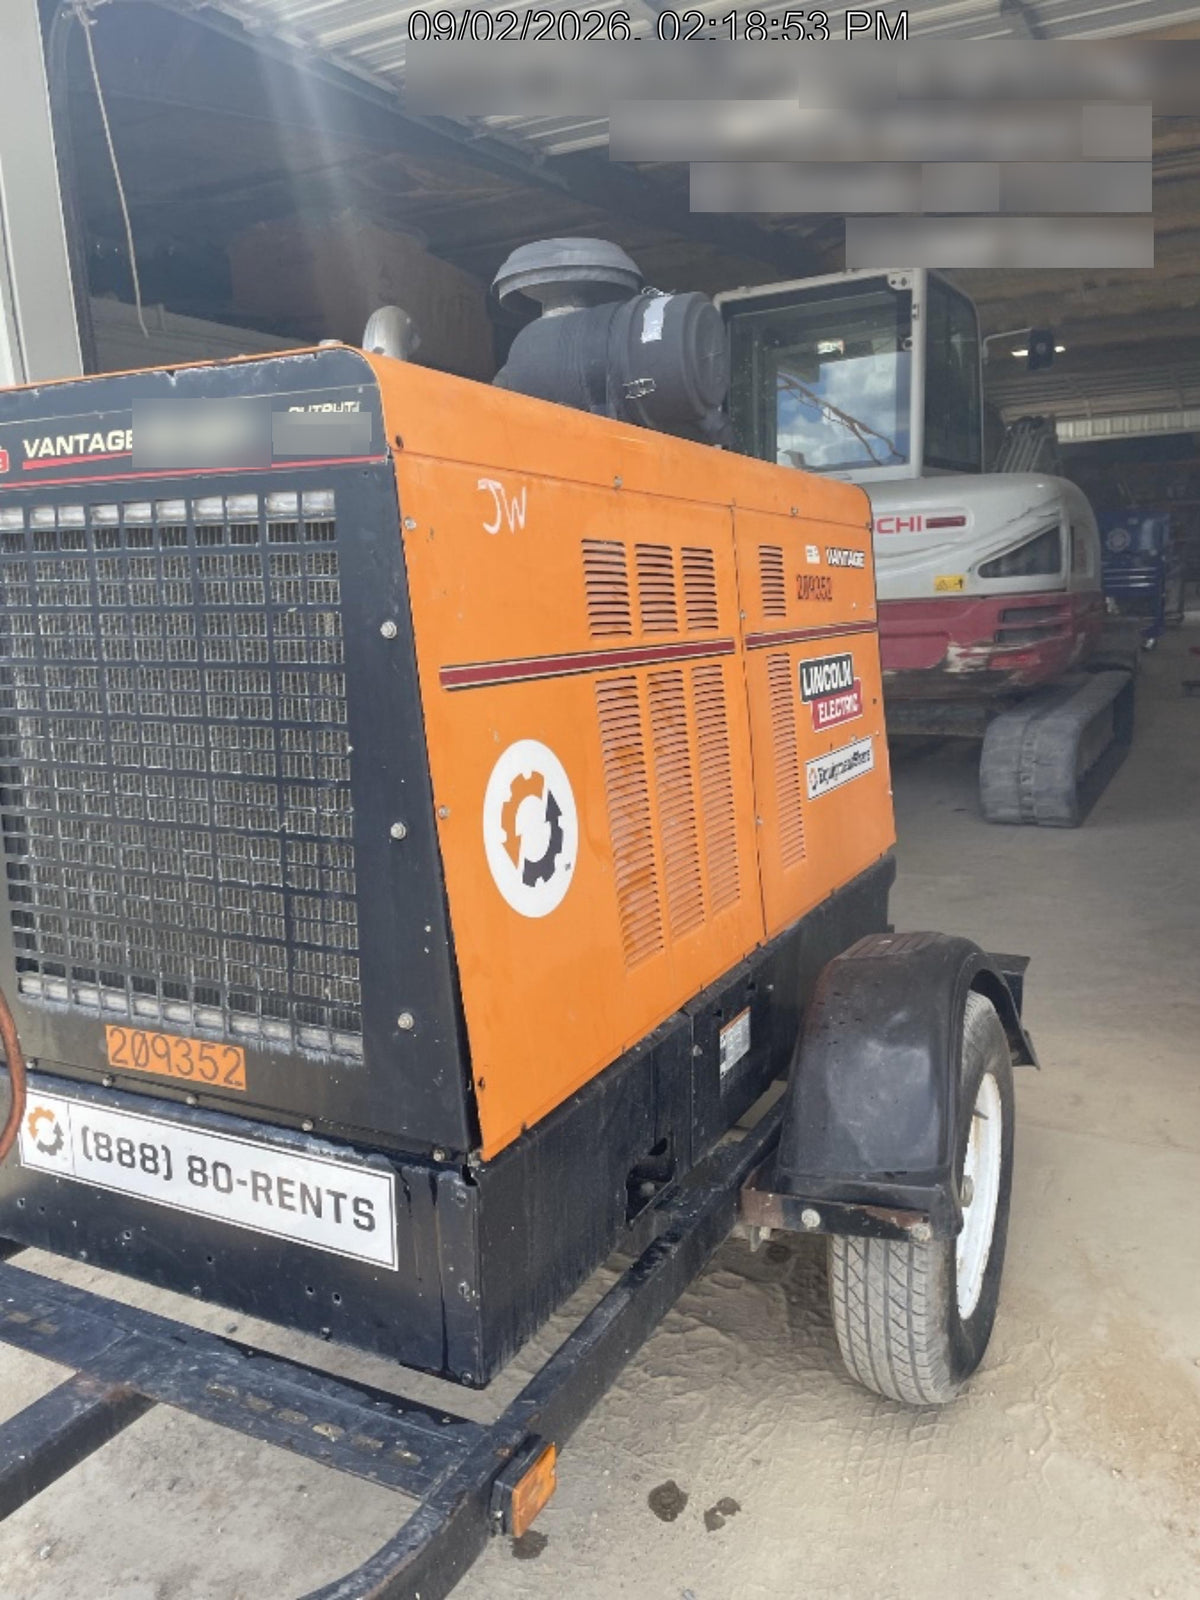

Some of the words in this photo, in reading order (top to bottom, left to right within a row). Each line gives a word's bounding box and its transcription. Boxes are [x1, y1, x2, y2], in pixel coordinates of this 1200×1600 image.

[22, 429, 133, 458] VANTAGE
[477, 478, 527, 535] JW
[873, 515, 922, 534] CHI
[825, 547, 865, 569] VANTAGE
[802, 660, 853, 696] LINCOLN
[817, 693, 858, 723] ELECTRIC
[109, 1027, 244, 1087] 209352
[81, 1125, 174, 1181] (888)
[187, 1155, 376, 1232] 80-RENTS
